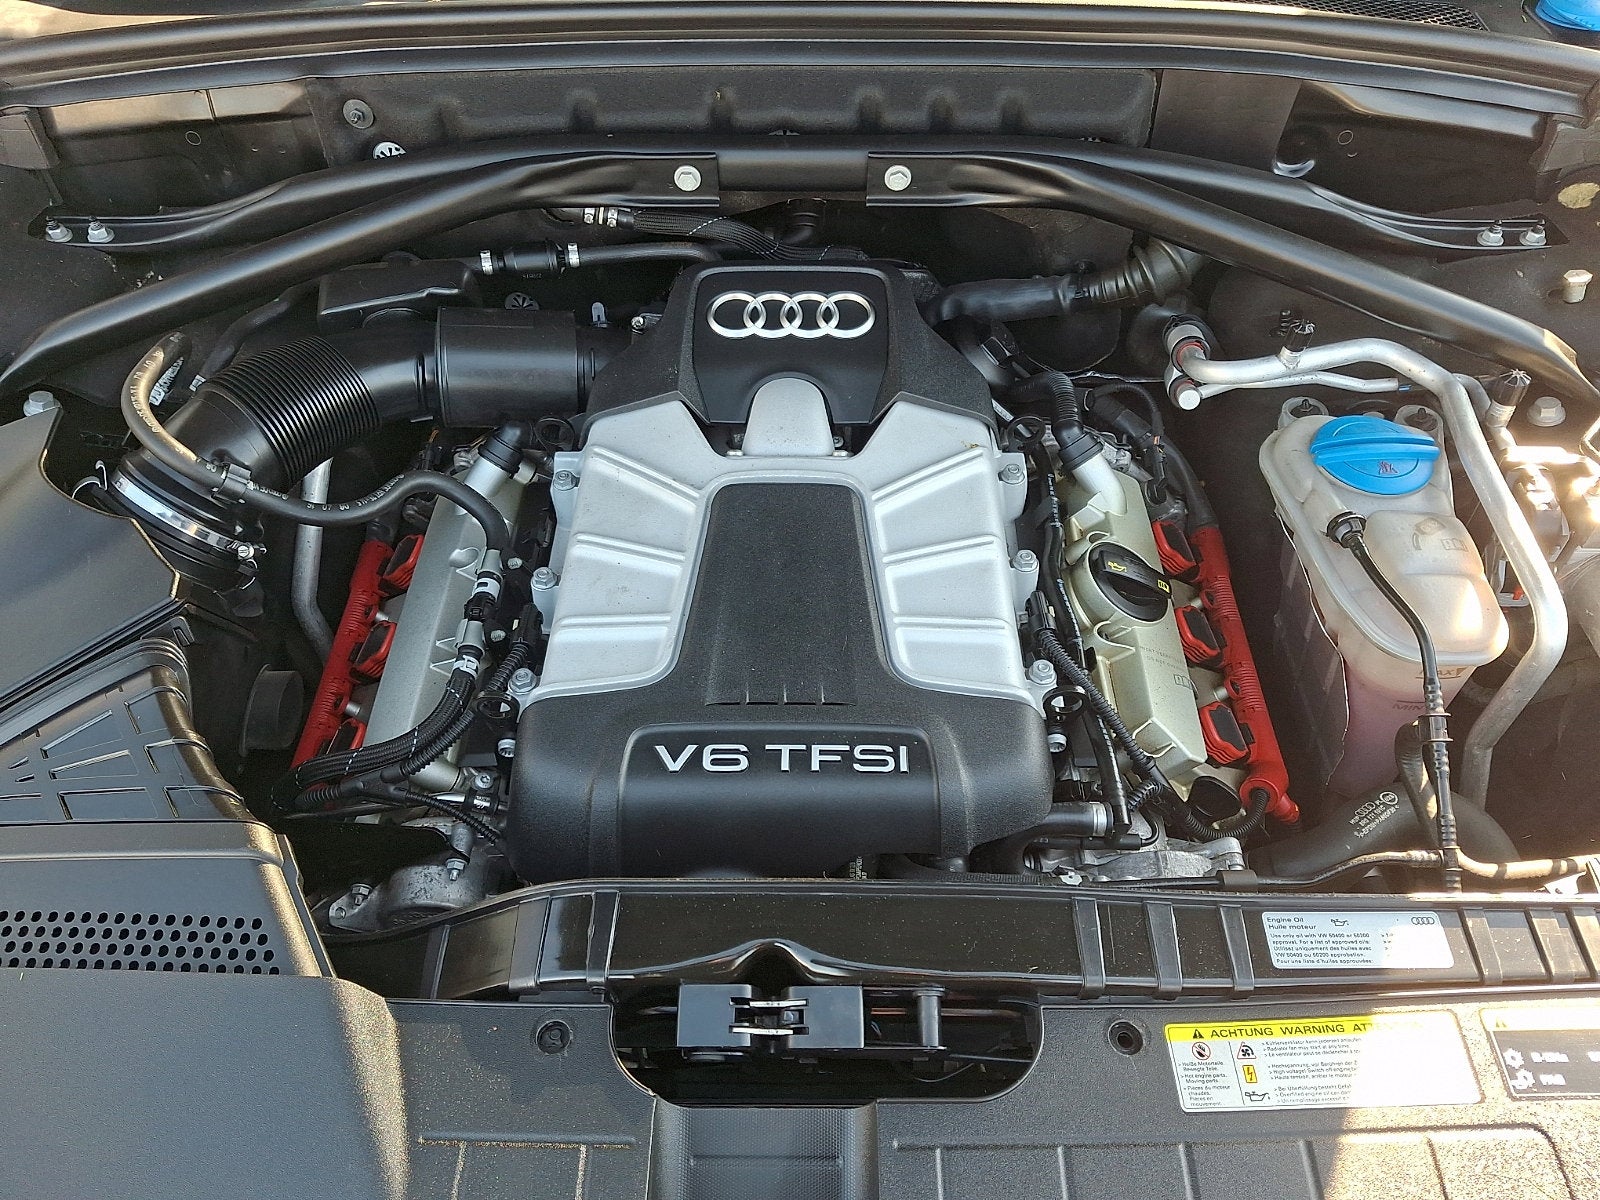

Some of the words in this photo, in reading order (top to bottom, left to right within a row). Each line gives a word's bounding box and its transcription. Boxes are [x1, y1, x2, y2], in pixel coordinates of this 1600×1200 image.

[654, 744, 749, 772] V6
[765, 744, 909, 773] TFSI
[1210, 1027, 1274, 1038] ACHTUNG
[1280, 1024, 1344, 1035] WARNING
